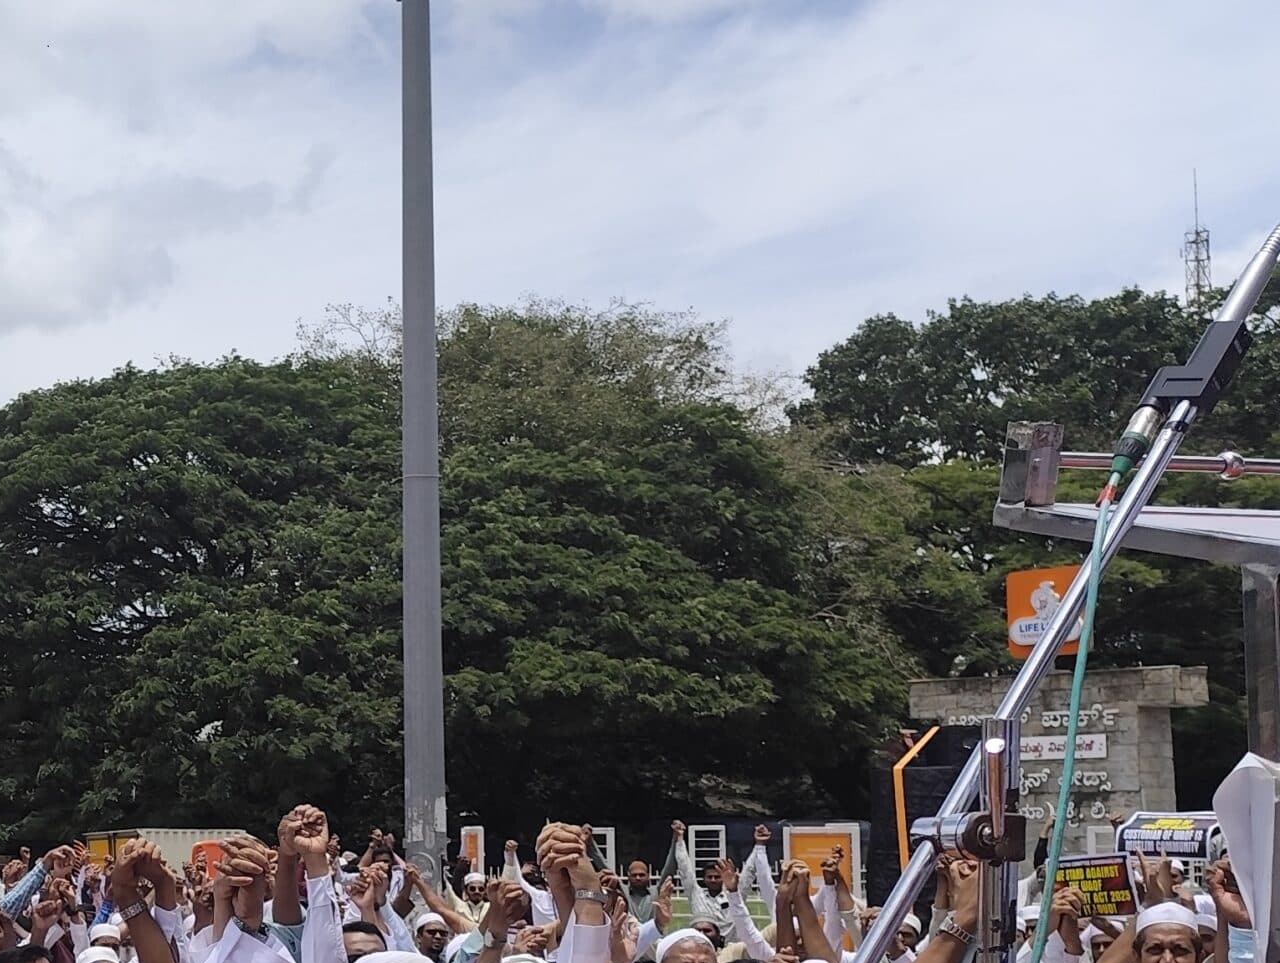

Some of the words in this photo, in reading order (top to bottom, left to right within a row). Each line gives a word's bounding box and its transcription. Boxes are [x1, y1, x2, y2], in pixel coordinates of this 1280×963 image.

[1019, 623, 1039, 632] LIFE
[1123, 829, 1162, 840] CUSTODIAN
[1065, 867, 1085, 881] STAND
[1086, 865, 1119, 879] AGAINST
[1093, 891, 1108, 904] ACT
